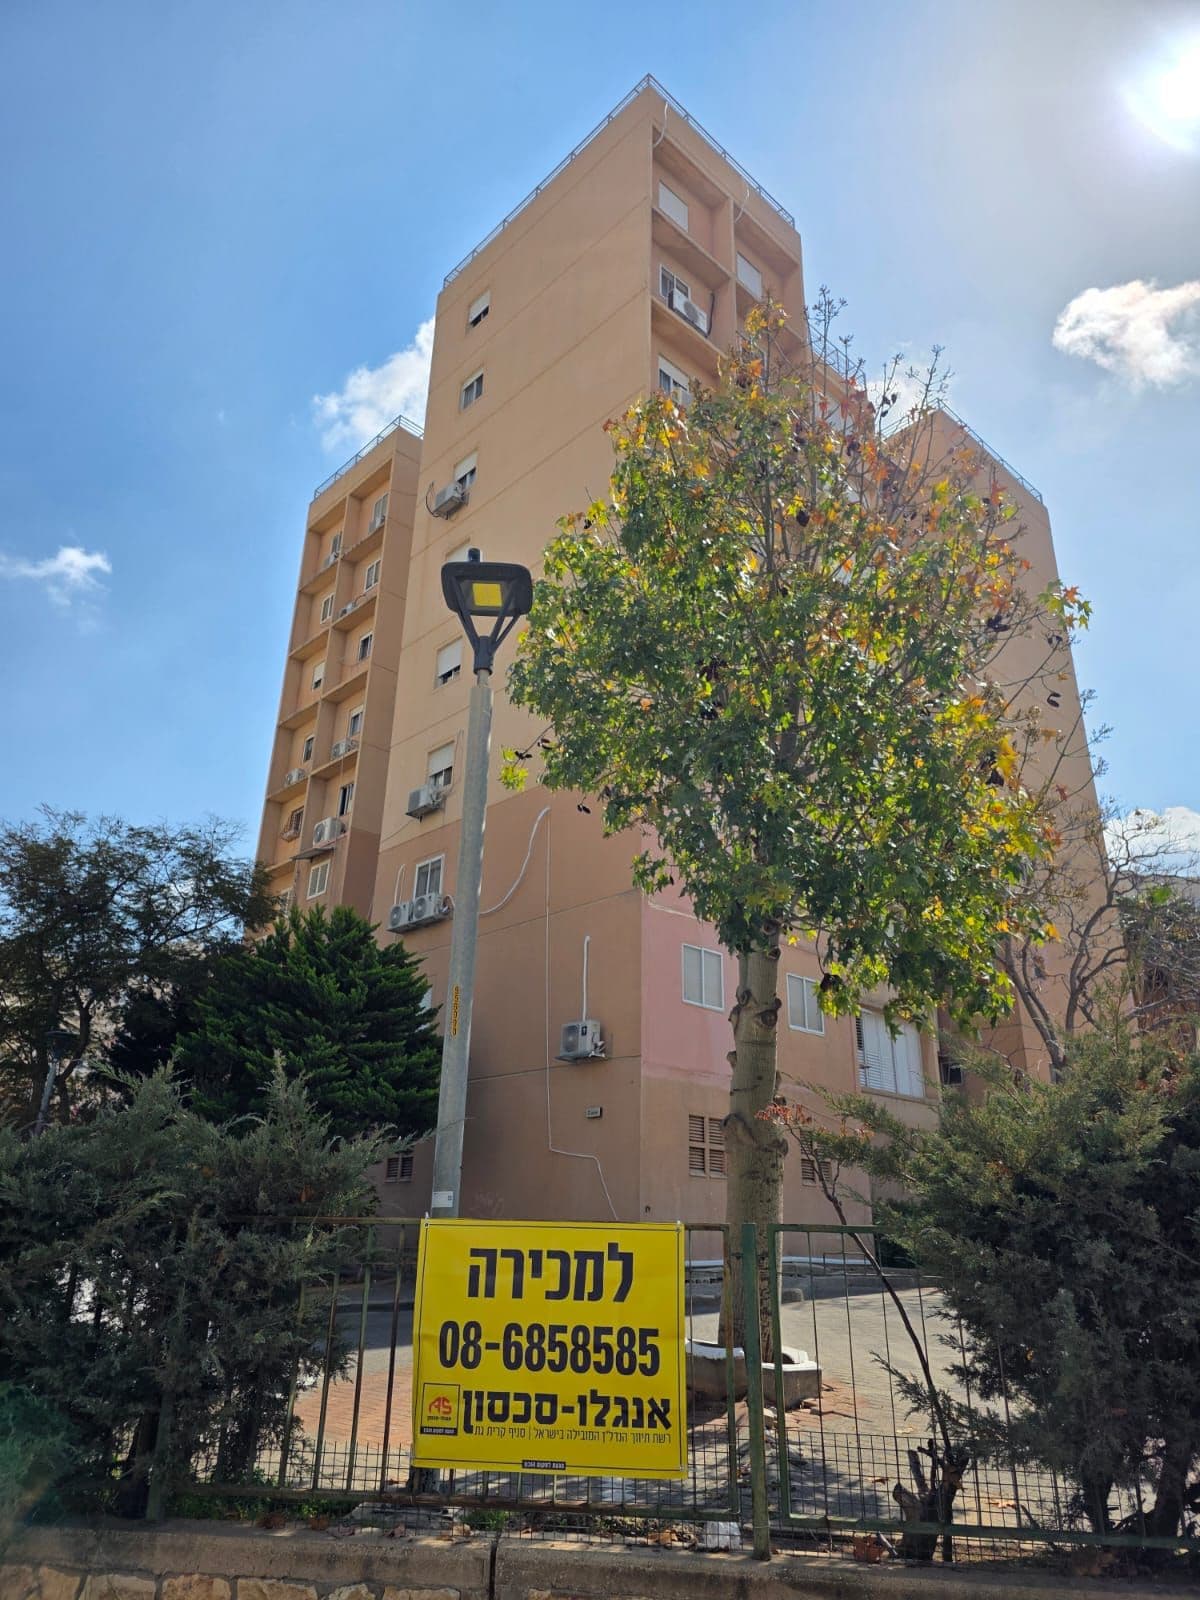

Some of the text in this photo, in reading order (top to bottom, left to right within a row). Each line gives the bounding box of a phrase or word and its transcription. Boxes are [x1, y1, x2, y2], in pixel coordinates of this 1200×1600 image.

[467, 1242, 633, 1303] למכירה
[439, 1320, 660, 1377] 08-6858585
[463, 1389, 672, 1434] אנגלו-סכסון
[486, 1425, 506, 1439] קרית
[508, 1427, 526, 1439] סניף
[533, 1426, 564, 1440] בישראל
[566, 1427, 600, 1441] המובילה
[652, 1432, 672, 1444] רשת
